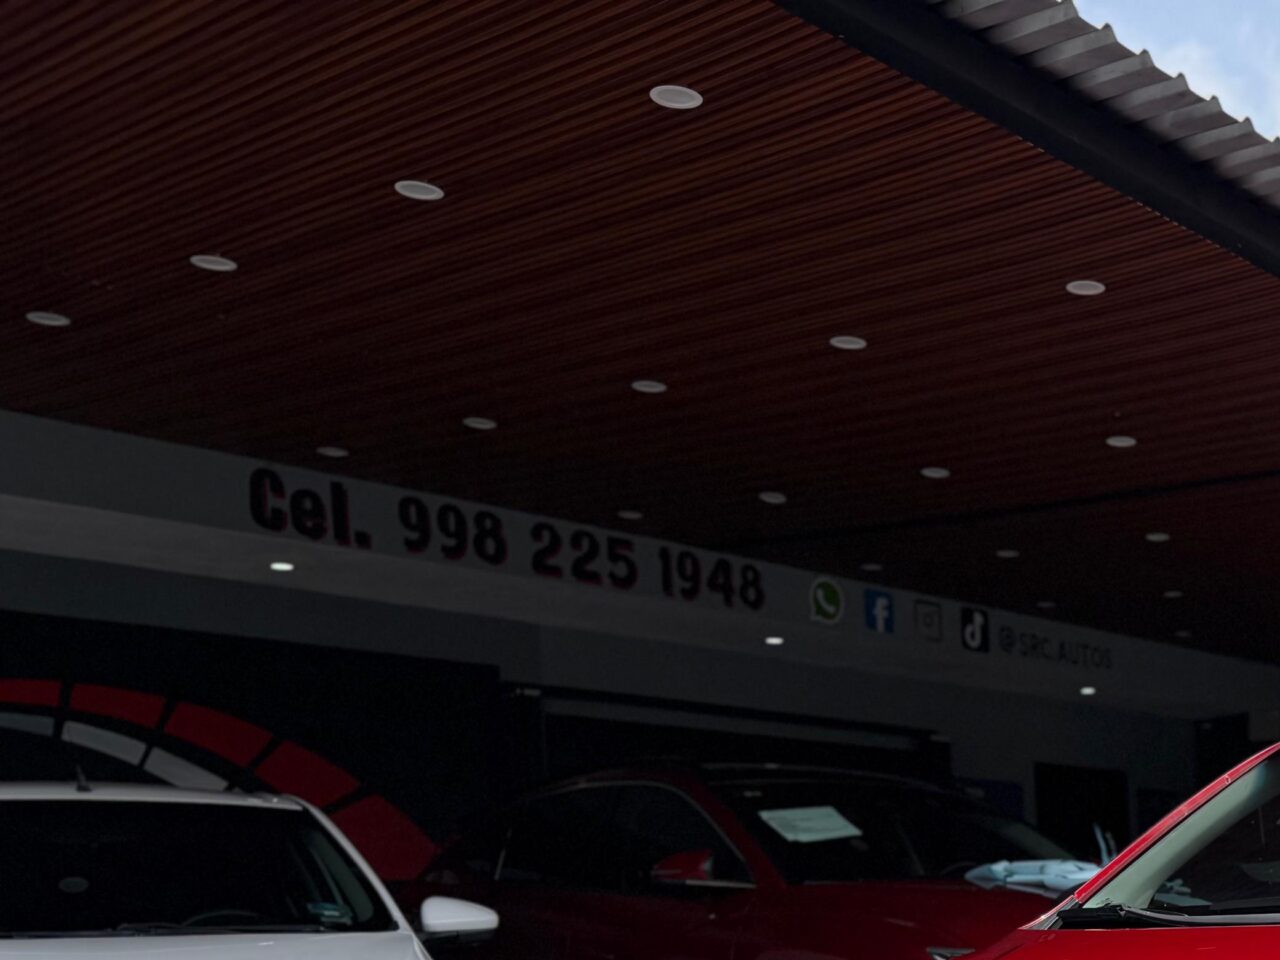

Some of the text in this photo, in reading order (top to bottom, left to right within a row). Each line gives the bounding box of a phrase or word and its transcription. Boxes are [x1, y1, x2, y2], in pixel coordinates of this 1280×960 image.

[249, 467, 765, 611] Cel. 998 225 1948
